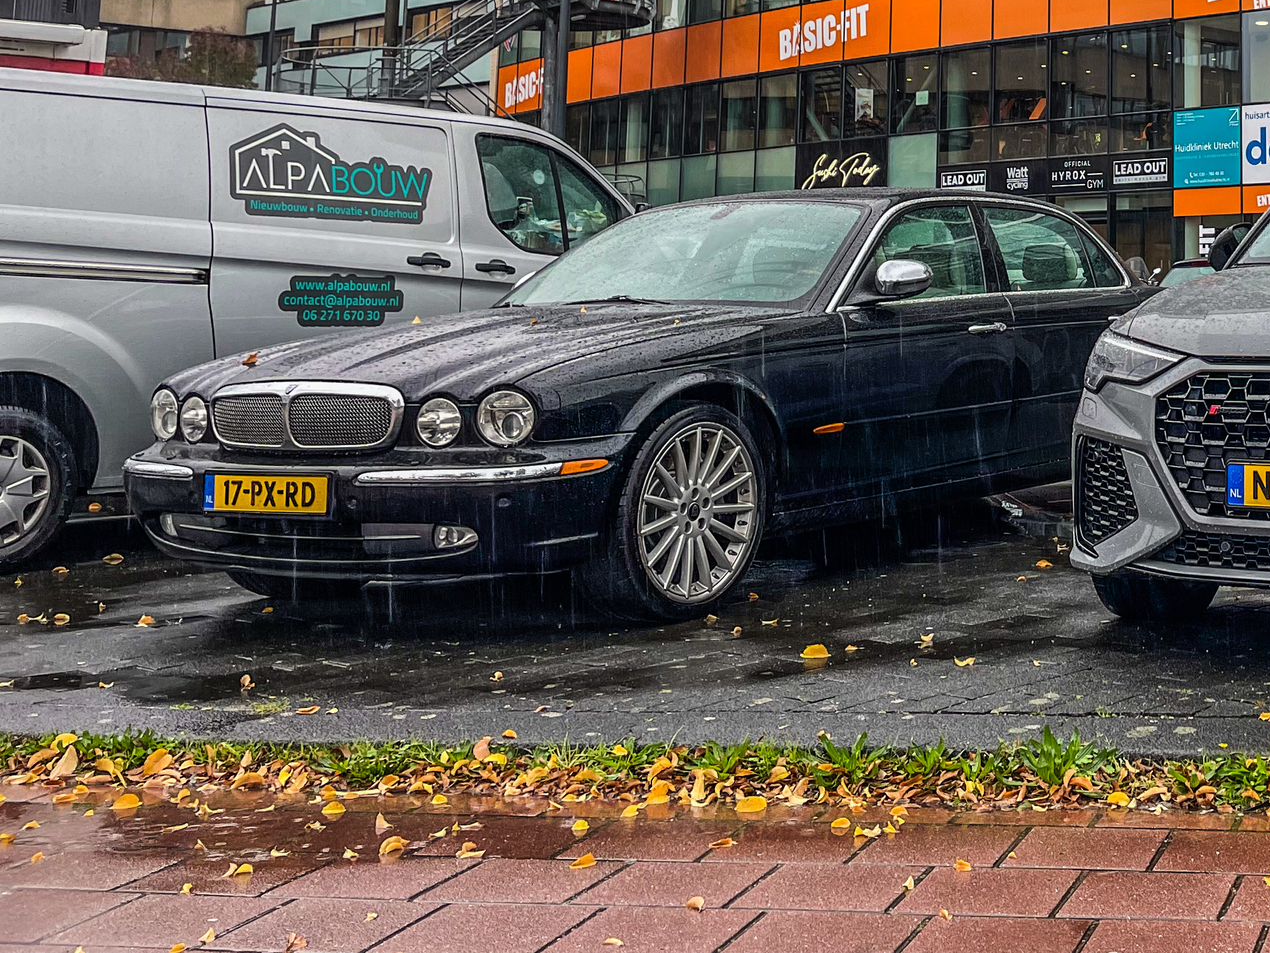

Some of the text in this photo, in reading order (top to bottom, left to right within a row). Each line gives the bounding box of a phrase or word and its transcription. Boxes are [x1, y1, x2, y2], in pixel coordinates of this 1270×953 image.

[778, 3, 870, 61] BASIC-FIT
[1175, 140, 1239, 152] Huidkliniek Utrecht
[1064, 160, 1091, 168] OFFICIAL
[1115, 161, 1166, 175] LEAD OUT
[242, 149, 428, 199] ALPABOUW
[802, 152, 880, 190] Sushi Today
[1006, 166, 1028, 179] Watt
[1051, 170, 1086, 181] HYROX
[942, 173, 985, 186] LEAD OUT
[1006, 181, 1028, 190] cycling
[1086, 179, 1104, 189] GYM
[250, 199, 419, 220] Nieuwbouw Renovatie Onderhoud
[295, 279, 391, 293] www.alpabouw.nl
[283, 294, 399, 308] contact@alpabouw.nl
[302, 309, 380, 321] 06 271 670 30
[205, 480, 316, 508] NL 17-PX-RD
[1230, 488, 1242, 498] NL
